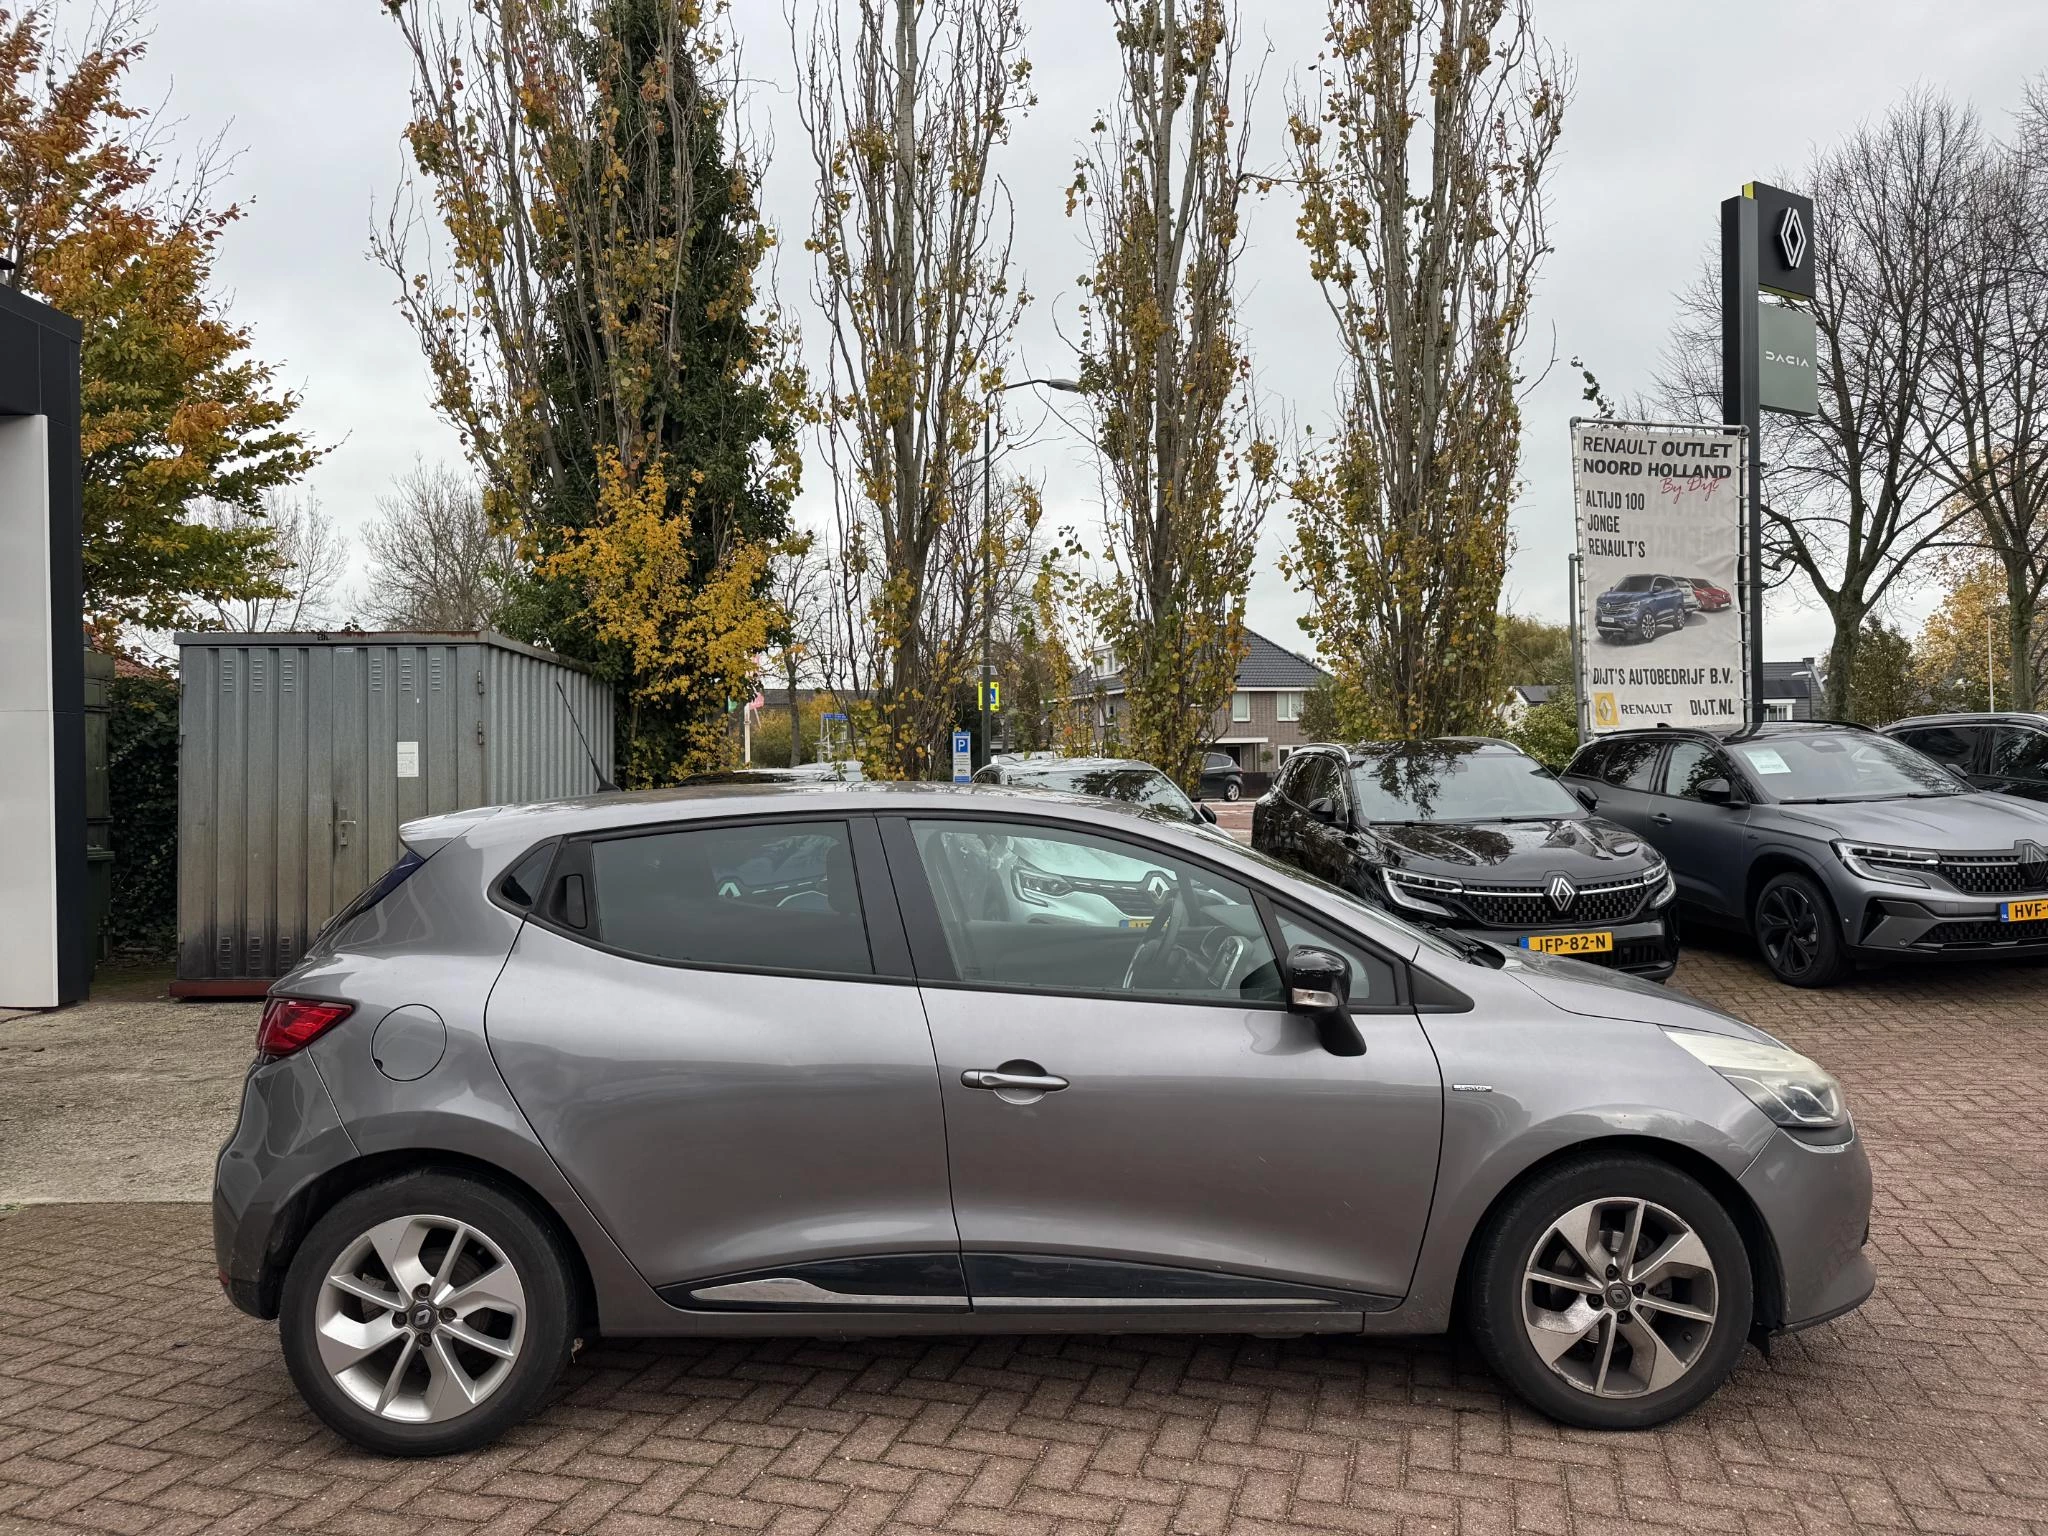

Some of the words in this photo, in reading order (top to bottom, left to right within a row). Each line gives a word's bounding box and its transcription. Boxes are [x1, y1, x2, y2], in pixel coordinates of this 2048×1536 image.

[1765, 351, 1809, 367] DACIA
[1583, 437, 1657, 455] RENAULT
[1661, 441, 1732, 458] OUTLET
[1583, 458, 1642, 476] NOORD
[1648, 463, 1731, 479] HOLLAND
[1586, 490, 1621, 509] ALTIJD
[1625, 494, 1645, 510] 100
[1588, 514, 1620, 533] JONGE
[1589, 538, 1645, 558] RENAULT'S
[1593, 668, 1625, 685] DIJT'S
[1629, 668, 1705, 685] AUTOBEDRIJF
[1710, 667, 1733, 684] B.V.
[1621, 704, 1672, 715] RENAULT
[1690, 699, 1734, 716] DIJT.NL
[958, 739, 966, 751] P
[2015, 903, 2048, 918] HVF-
[1538, 935, 1606, 952] JFP-82-N
